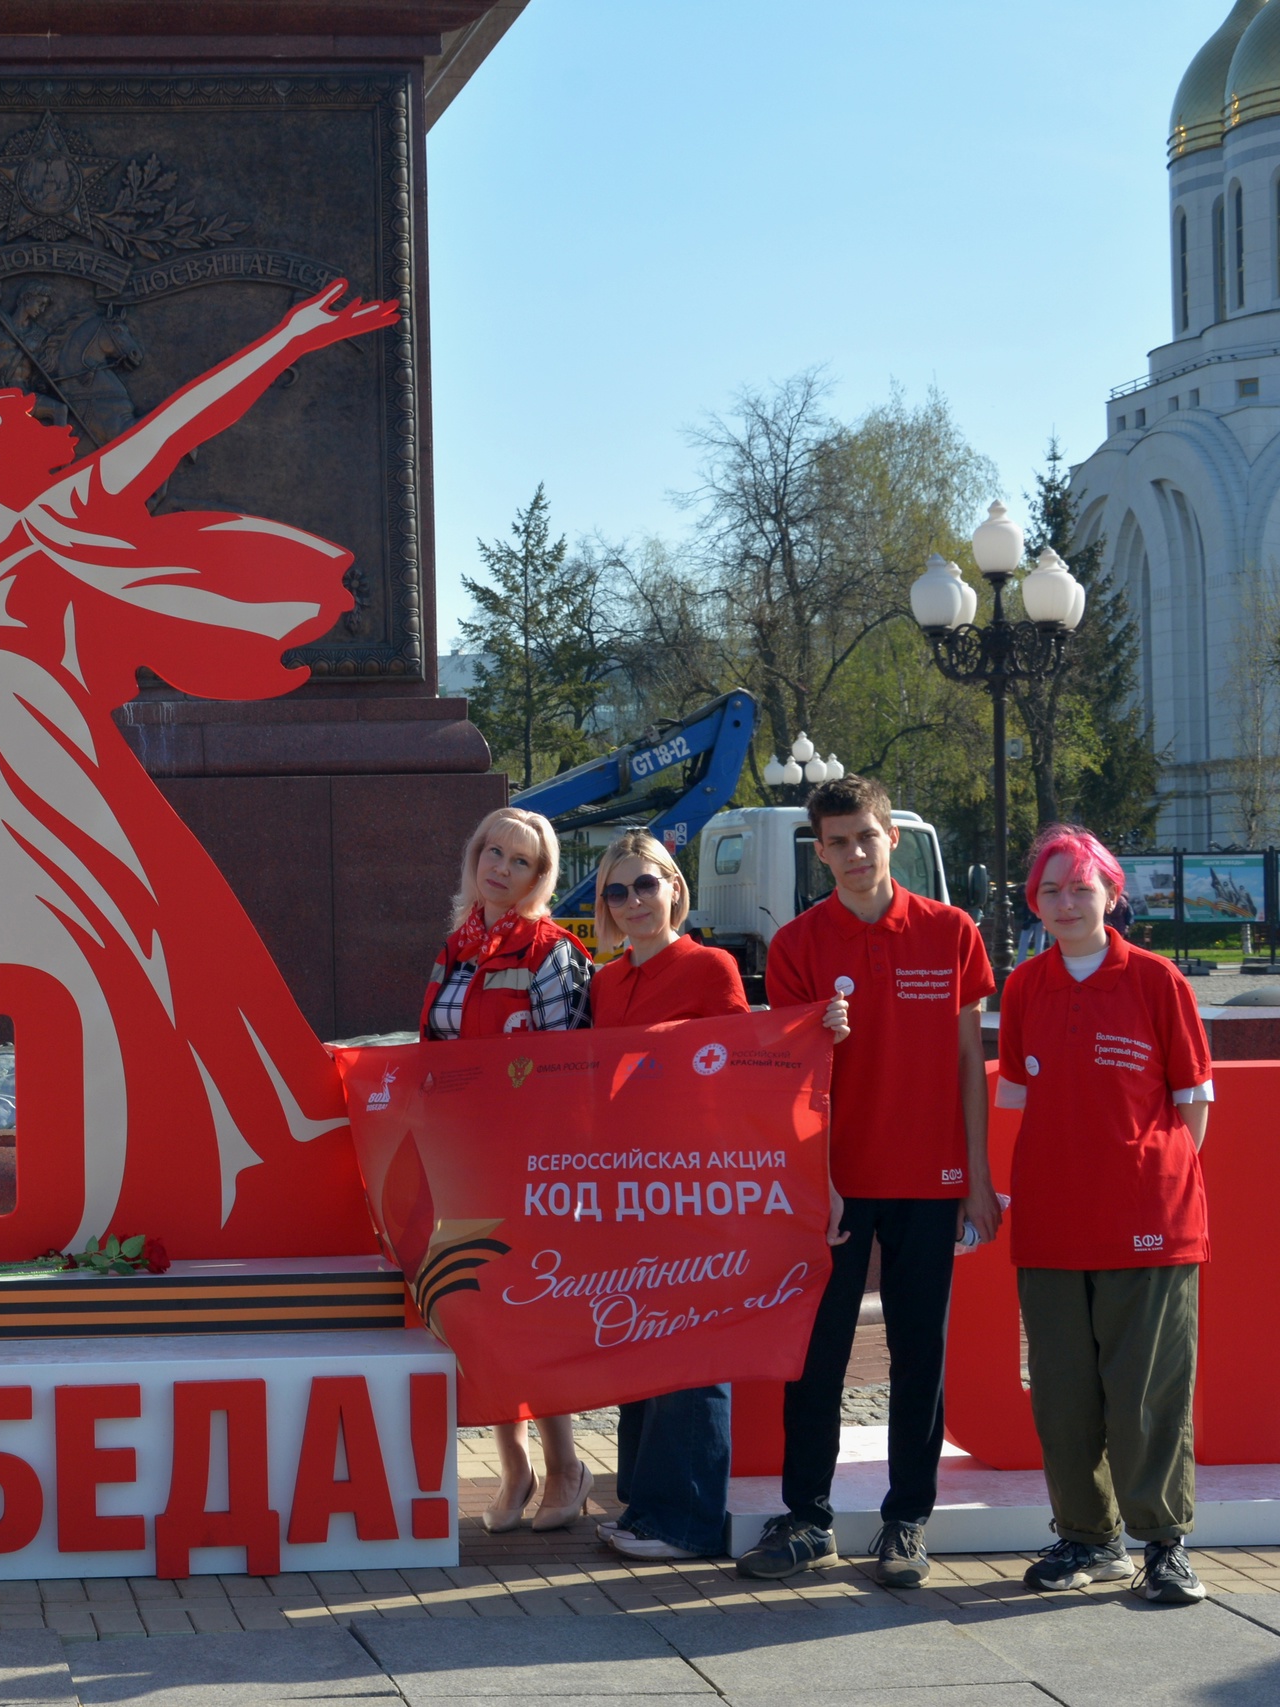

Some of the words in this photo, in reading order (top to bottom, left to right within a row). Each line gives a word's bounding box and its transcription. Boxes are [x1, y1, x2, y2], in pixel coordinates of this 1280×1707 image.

[130, 253, 331, 296] ПОСВЯЩАЕТСЯ
[632, 751, 654, 776] GT
[651, 735, 691, 767] 18-12
[896, 979, 929, 989] Грантовый
[731, 1050, 791, 1060] РОССИЙСКИЙ
[1094, 1044, 1131, 1056] Грантовый
[536, 1064, 561, 1074] ФМБА
[562, 1060, 600, 1072] РОССИИ
[730, 1059, 772, 1067] КРАСНЫЙ
[774, 1060, 803, 1069] КРЕСТ
[368, 1092, 383, 1104] 80
[527, 1148, 700, 1172] ВСЕРОССИЙСКАЯ
[706, 1150, 786, 1171] АКЦИЯ
[941, 1168, 963, 1181] БФУ
[524, 1182, 602, 1222] КОД
[615, 1180, 794, 1222] ДОНОРА
[1133, 1234, 1163, 1247] БФУ
[502, 1248, 750, 1306] Защитники
